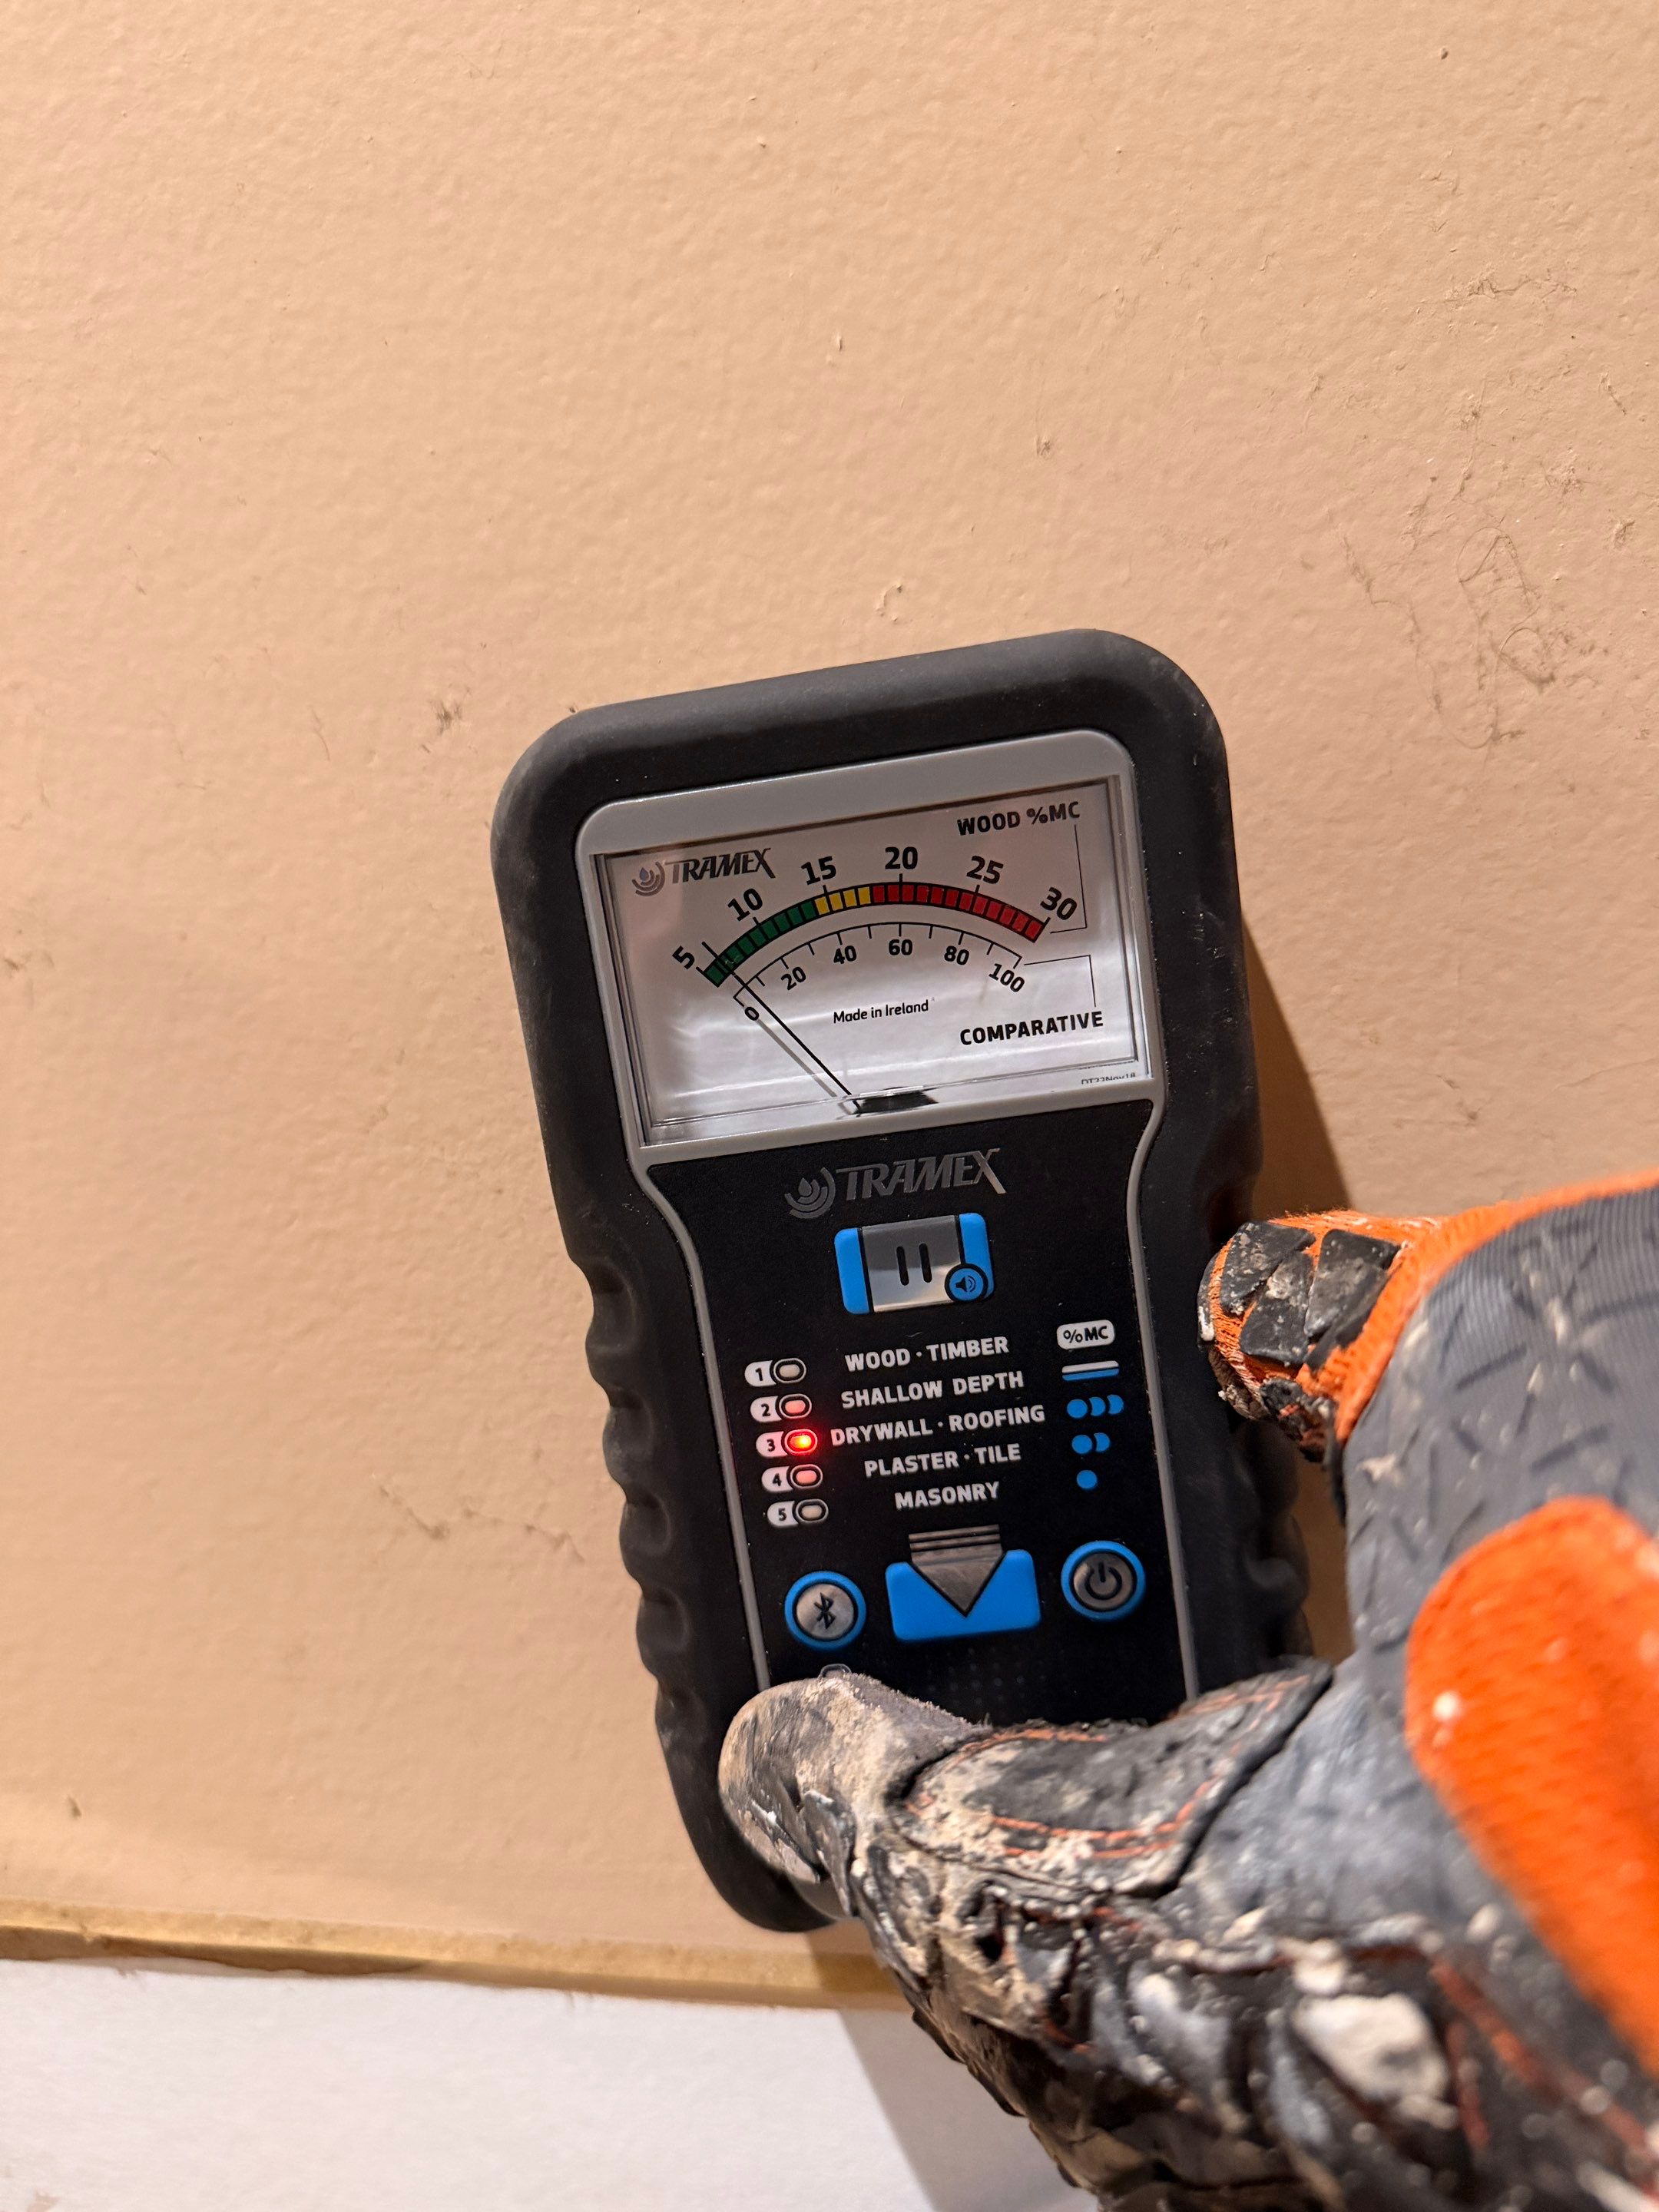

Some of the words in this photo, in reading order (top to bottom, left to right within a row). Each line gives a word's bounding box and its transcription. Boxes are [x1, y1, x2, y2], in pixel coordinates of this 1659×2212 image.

[958, 812, 1021, 836] WOOD
[1026, 801, 1081, 826] %MC
[665, 847, 776, 884] TRAMEX
[672, 945, 696, 969] 5
[727, 887, 763, 922] 10
[800, 856, 837, 886] 15
[884, 846, 919, 870] 20
[965, 855, 1004, 885] 25
[1039, 886, 1078, 921] 30
[744, 1006, 760, 1022] 0
[780, 965, 808, 992] 20
[832, 945, 859, 965] 40
[887, 938, 913, 957] 60
[943, 945, 970, 966] 80
[988, 962, 1025, 994] 100
[833, 1008, 868, 1024] Made
[871, 1006, 882, 1018] in
[885, 998, 929, 1017] Ireland
[959, 1011, 1104, 1045] COMPARATIVE
[836, 1147, 1007, 1201] TRAMEX
[1063, 1325, 1108, 1343] %MC
[844, 1347, 911, 1373] WOOD
[926, 1336, 1010, 1363] TIMBER
[755, 1367, 763, 1382] 1
[840, 1380, 943, 1410] SHALLOW
[952, 1370, 1025, 1396] DEPTH
[760, 1403, 771, 1418] 2
[830, 1417, 934, 1447] DRYWALL
[949, 1404, 1046, 1433] ROOFING
[767, 1438, 777, 1452] 3
[864, 1452, 959, 1479] PLASTER
[973, 1442, 1022, 1465] TILE
[771, 1473, 782, 1487] 4
[894, 1481, 999, 1511] MASONRY
[777, 1508, 786, 1522] 5
